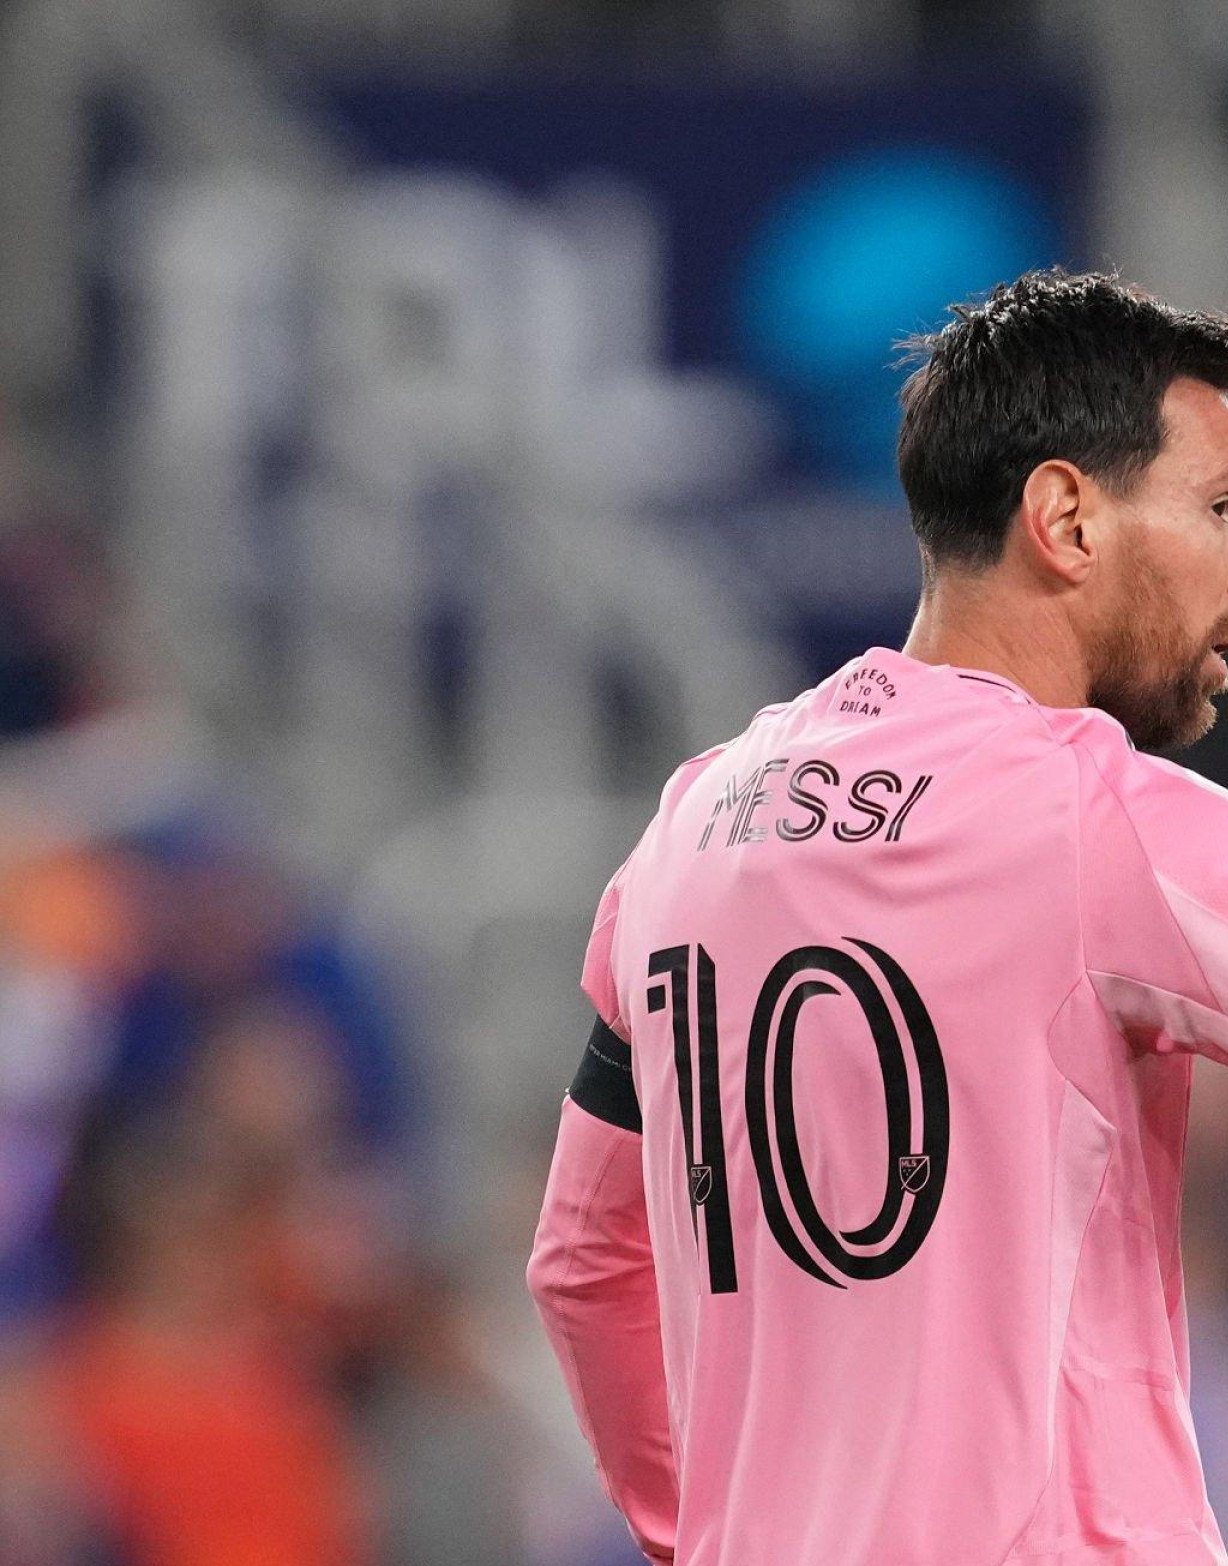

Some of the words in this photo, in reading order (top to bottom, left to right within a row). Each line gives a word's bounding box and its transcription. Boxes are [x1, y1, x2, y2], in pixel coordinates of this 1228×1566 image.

[858, 685, 872, 697] TO
[697, 758, 934, 852] MESSI
[646, 936, 950, 1294] 10
